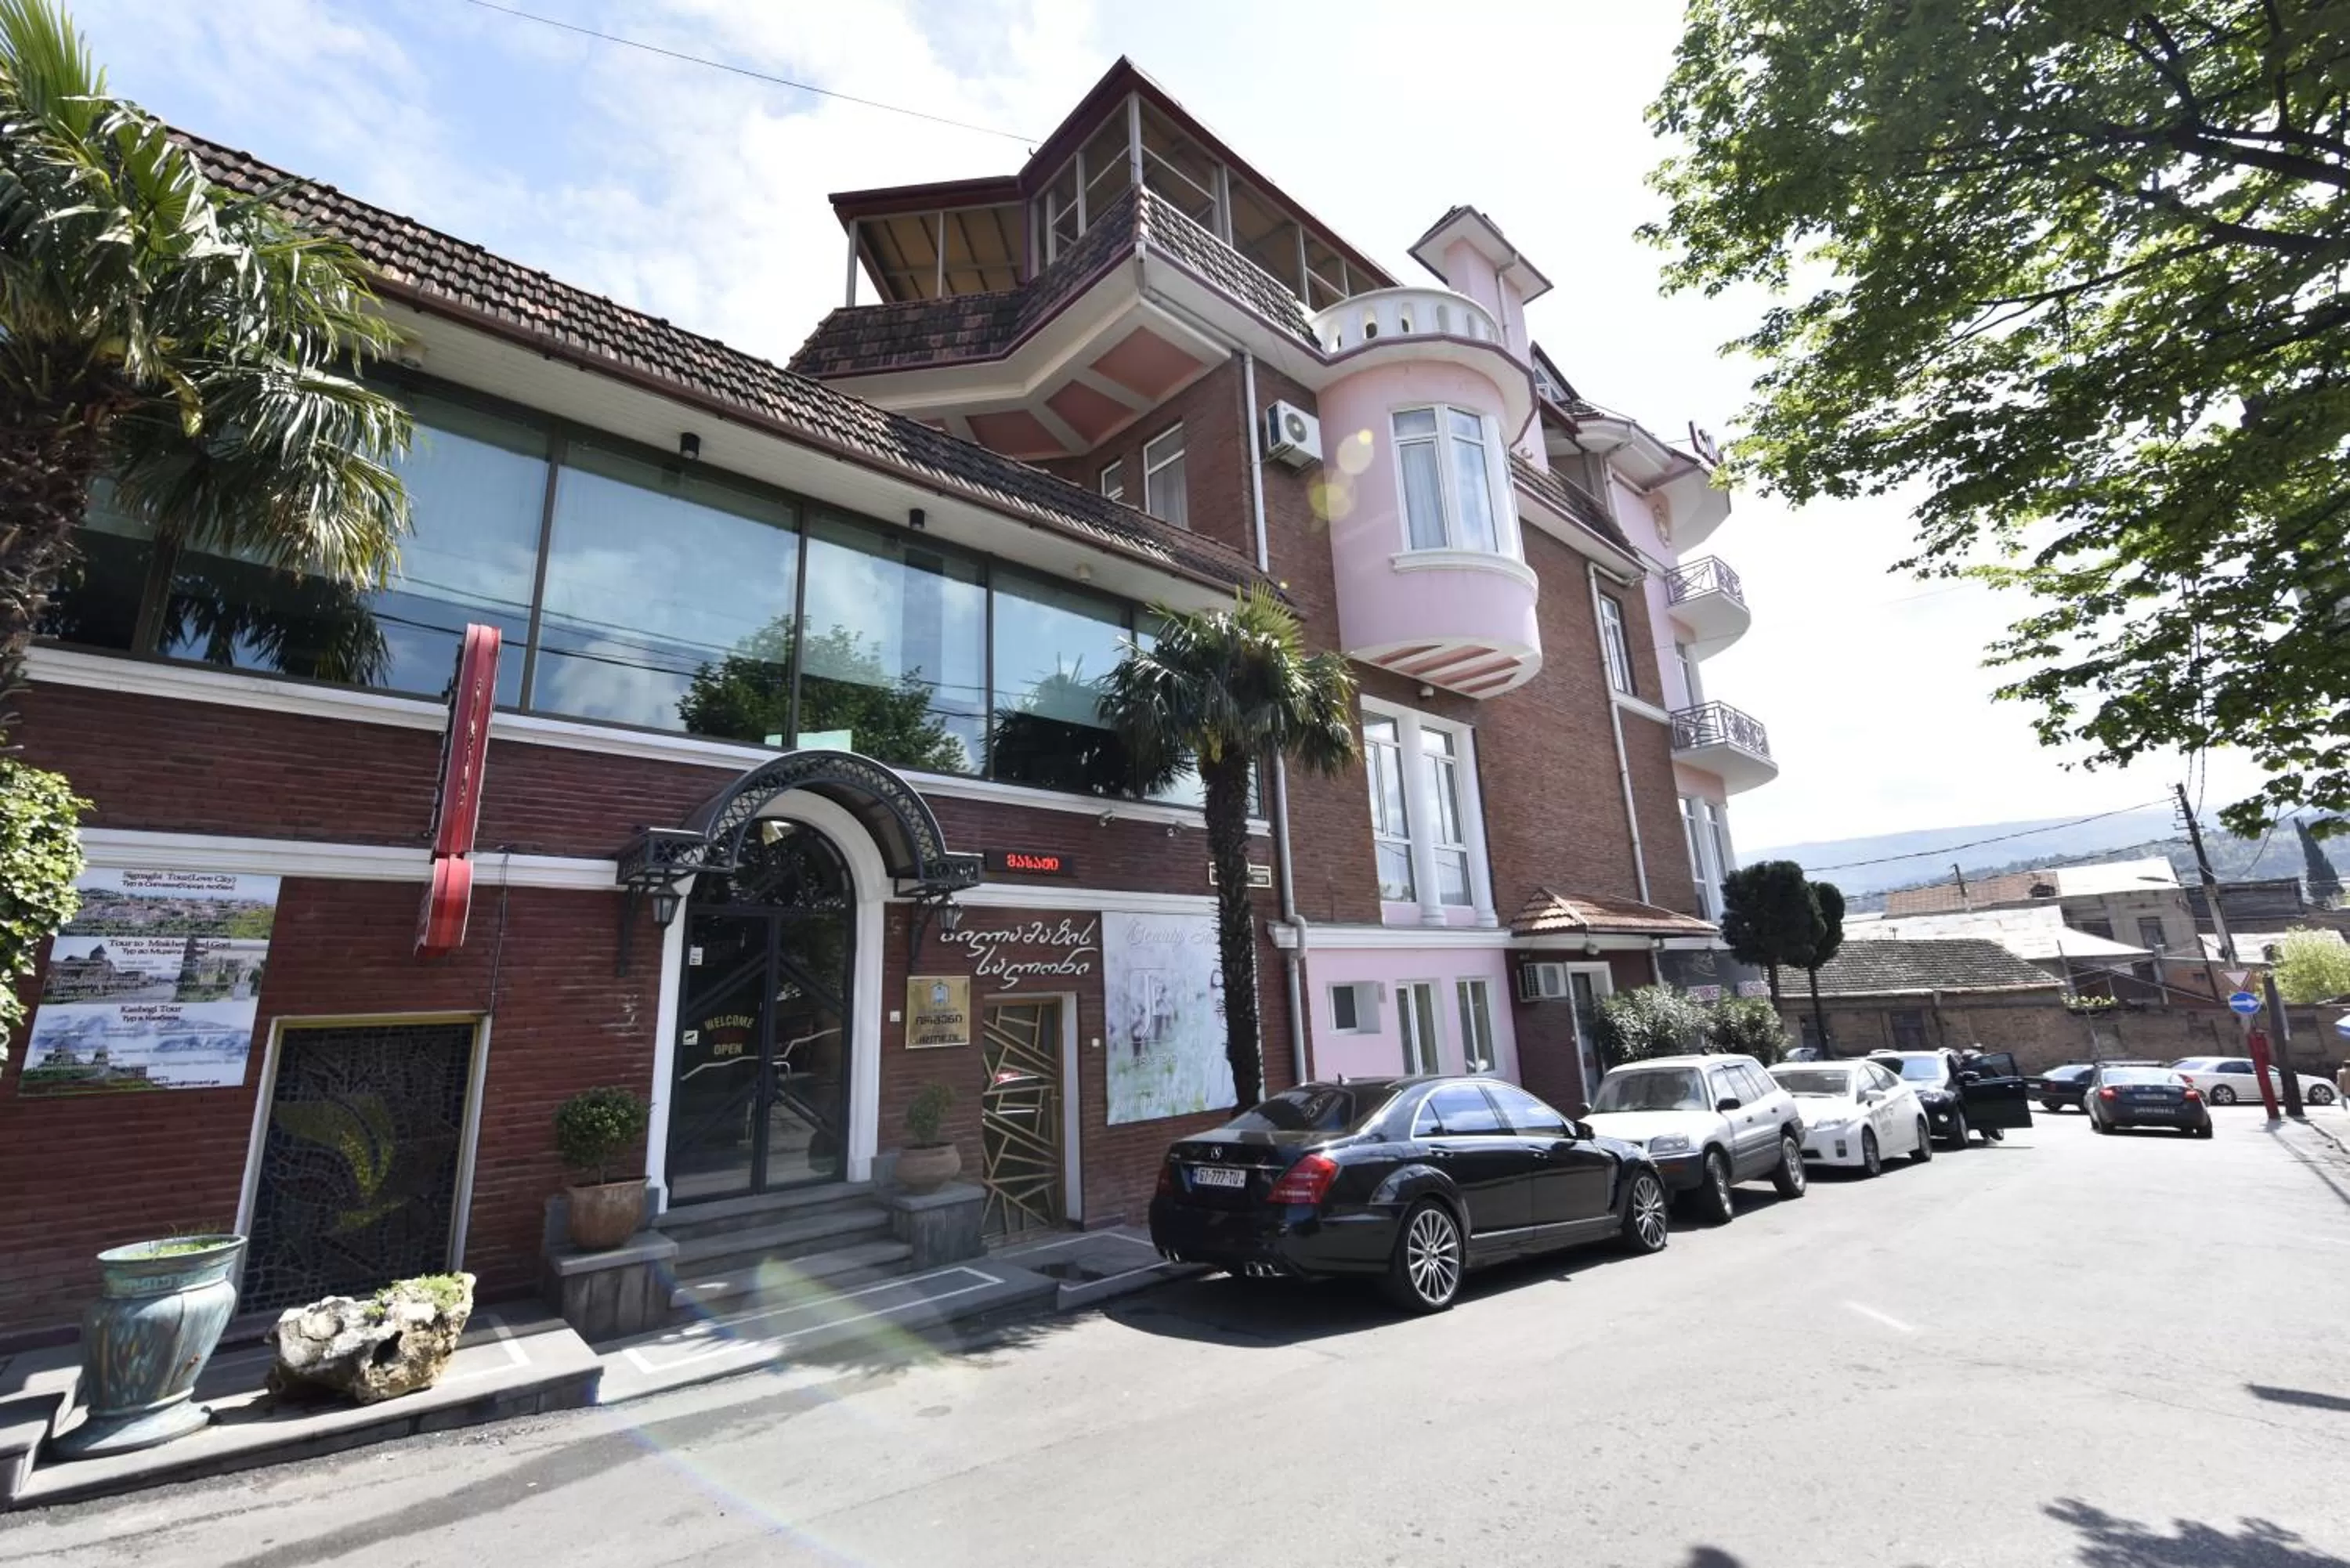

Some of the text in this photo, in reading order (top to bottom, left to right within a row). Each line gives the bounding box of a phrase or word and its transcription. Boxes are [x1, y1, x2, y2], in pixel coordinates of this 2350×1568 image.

[976, 945, 1098, 990] სალონი
[704, 1014, 755, 1031] WELCOME
[714, 1042, 743, 1056] OPEN
